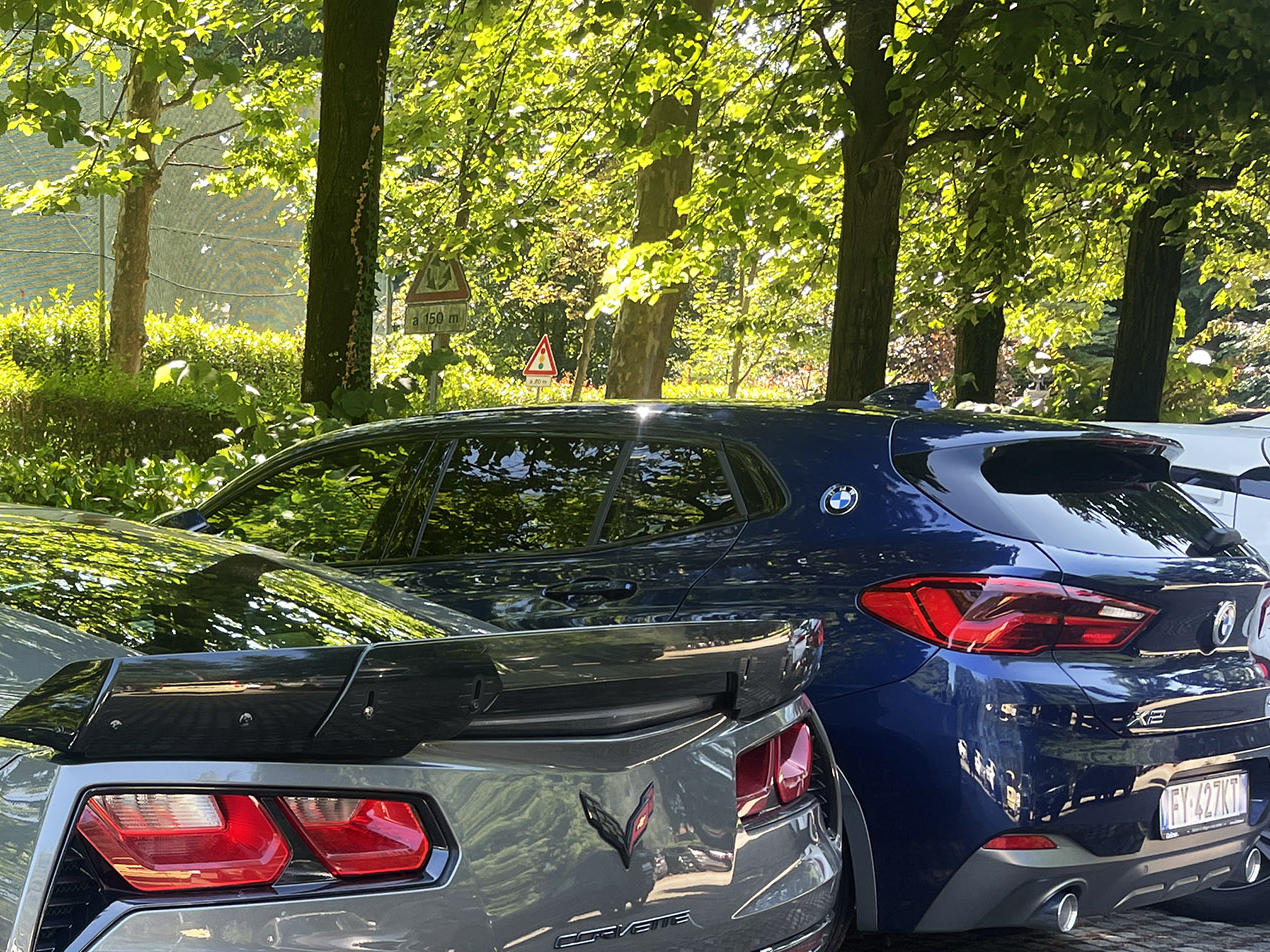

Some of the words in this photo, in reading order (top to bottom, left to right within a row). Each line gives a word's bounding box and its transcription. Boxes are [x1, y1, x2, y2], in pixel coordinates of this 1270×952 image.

[412, 316, 419, 326] a
[424, 312, 444, 325] 150
[448, 314, 459, 324] m
[1127, 708, 1167, 727] X2
[1171, 786, 1189, 826] FY
[1195, 777, 1238, 821] 427KT
[553, 910, 691, 949] CORVETTE
